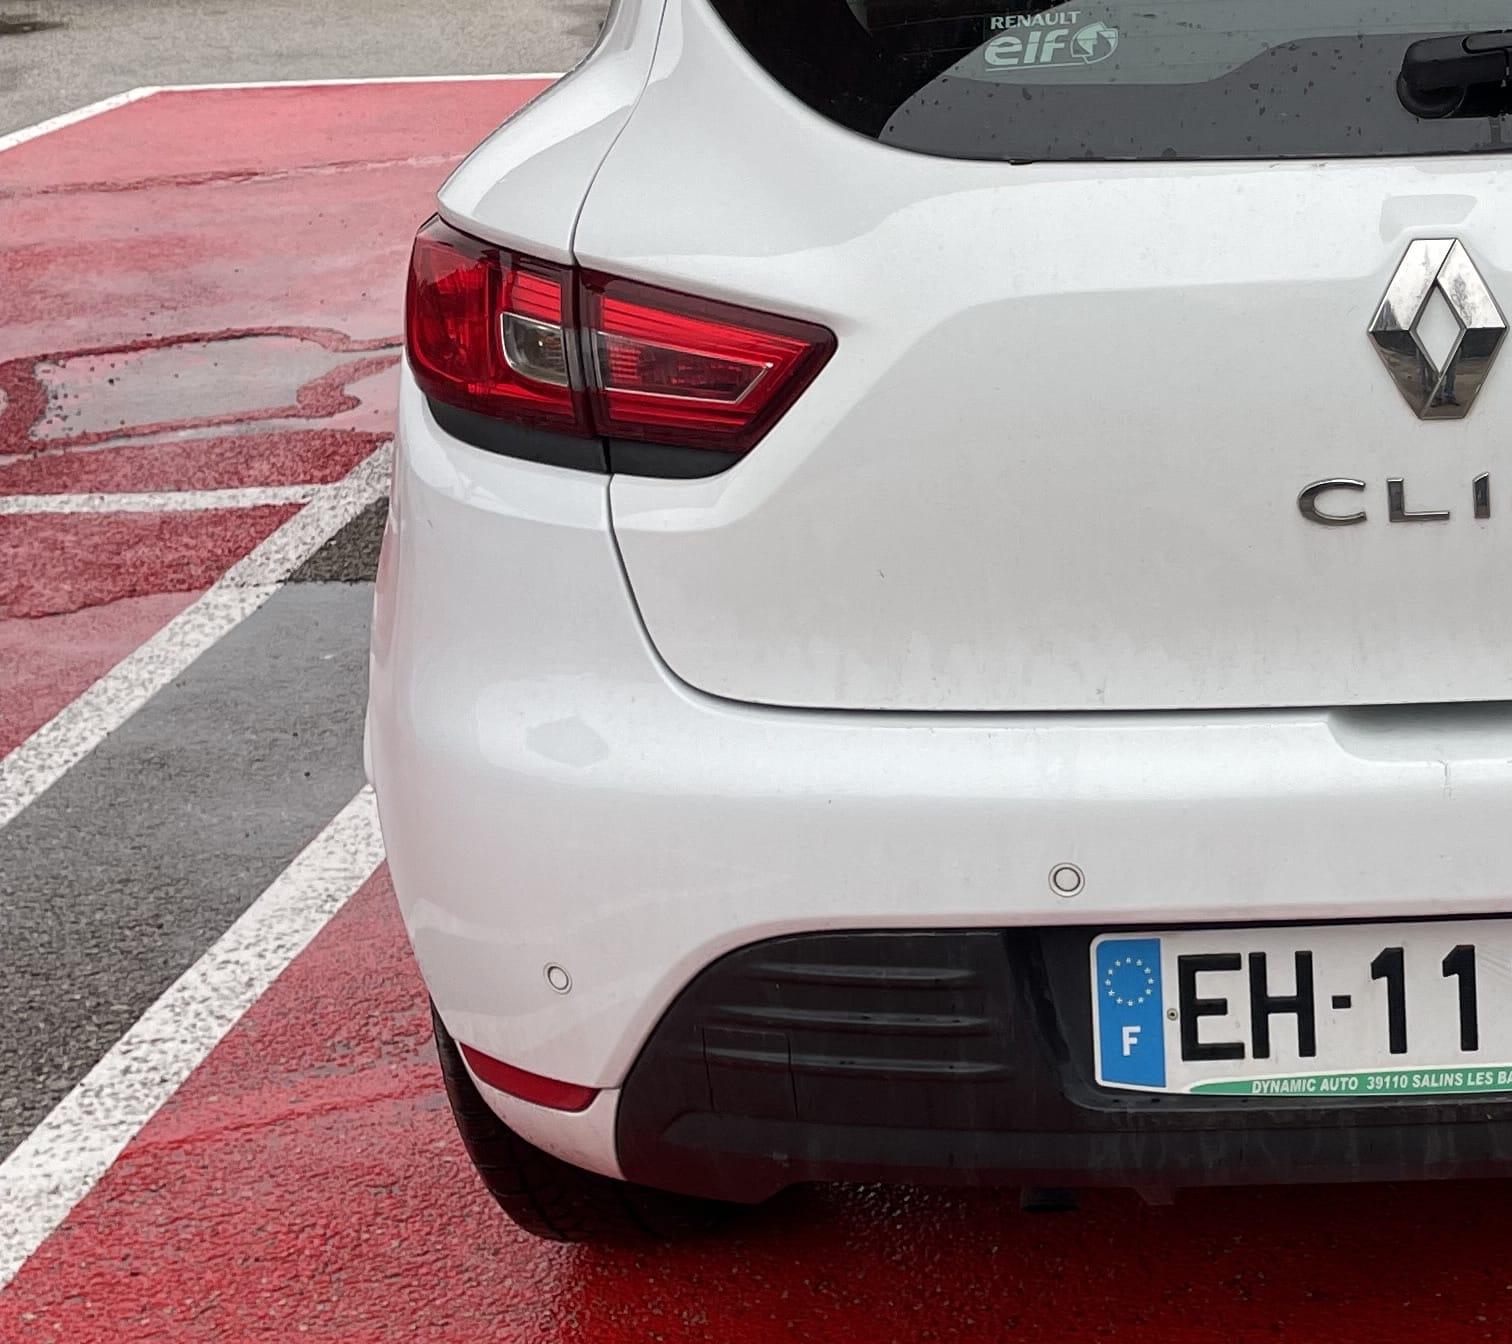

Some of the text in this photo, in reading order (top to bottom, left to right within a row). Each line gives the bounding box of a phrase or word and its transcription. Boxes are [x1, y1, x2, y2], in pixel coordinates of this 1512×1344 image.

[990, 10, 1081, 30] RENAULT
[984, 28, 1070, 66] elf
[1121, 1025, 1142, 1057] F
[1252, 1078, 1316, 1095] DYNAMIC
[1319, 1076, 1359, 1092] AUTO
[1366, 1074, 1408, 1090] 39110
[1411, 1072, 1464, 1089] SALINS
[1466, 1071, 1494, 1087] LES
